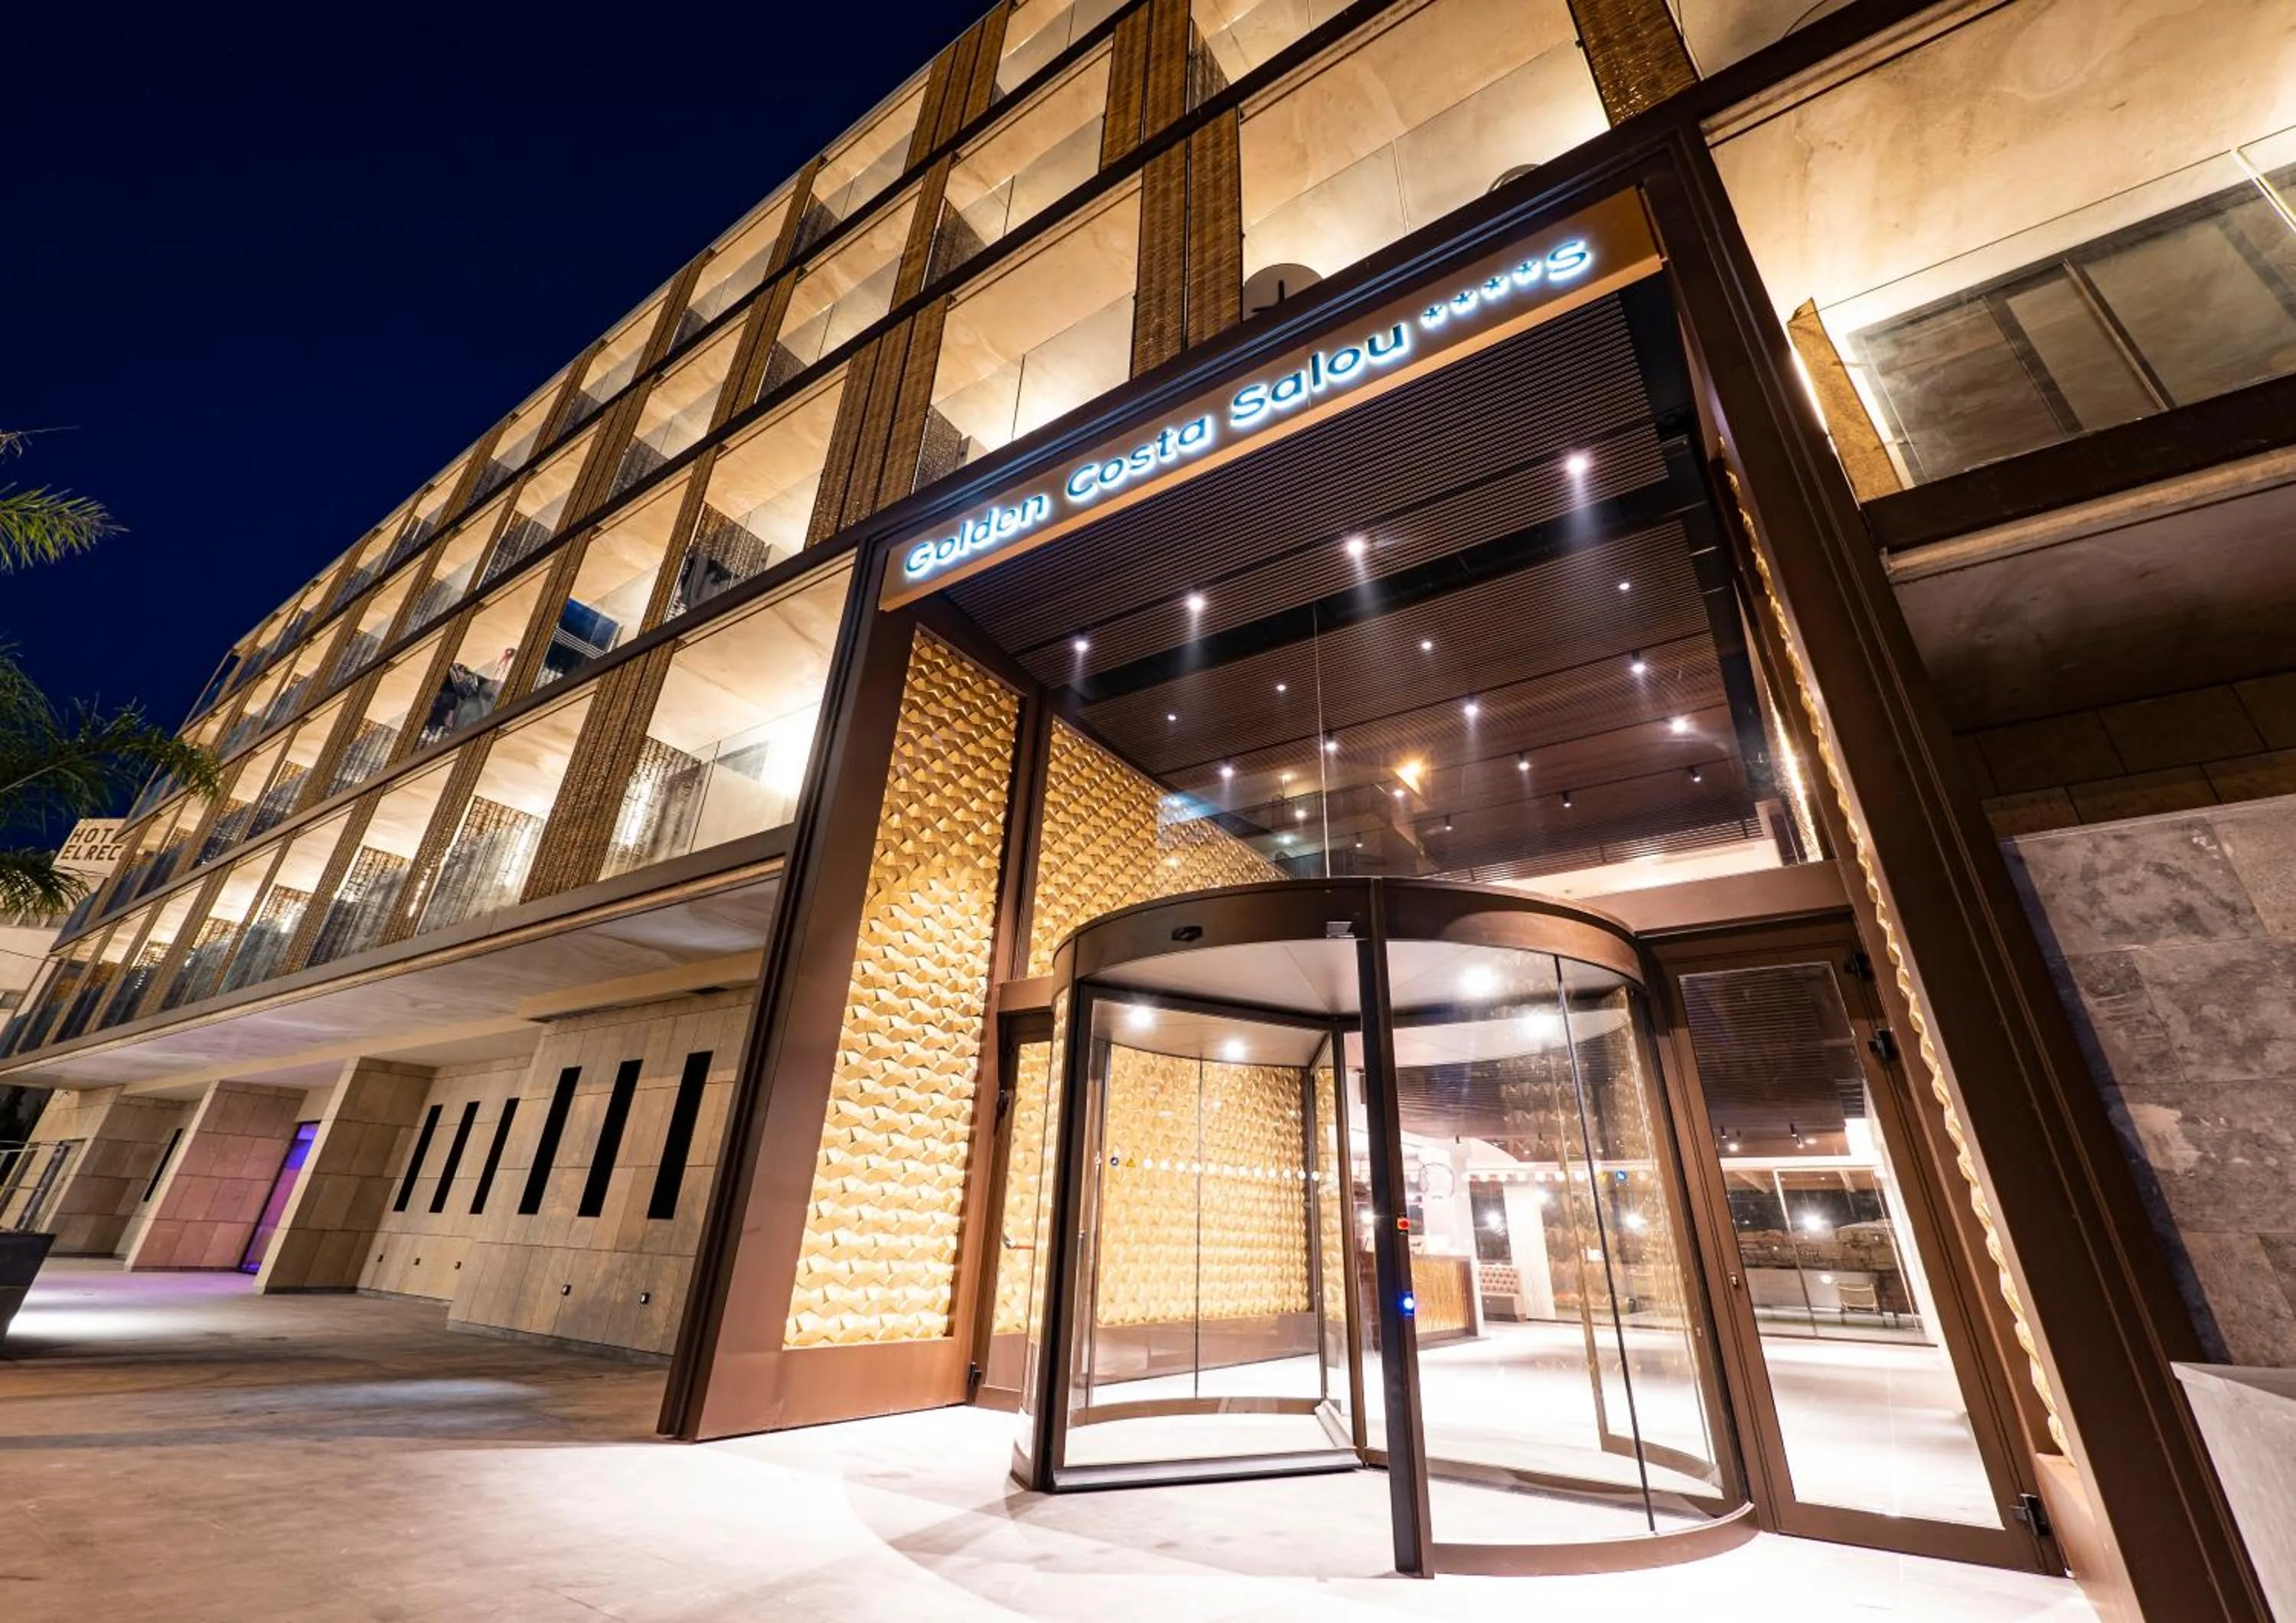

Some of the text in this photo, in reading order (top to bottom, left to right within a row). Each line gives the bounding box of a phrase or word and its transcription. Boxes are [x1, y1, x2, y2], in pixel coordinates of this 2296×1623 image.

[905, 494, 1049, 575] Golden
[1066, 416, 1212, 501] Costa
[1231, 322, 1408, 426] Salou
[70, 828, 116, 844] HOT
